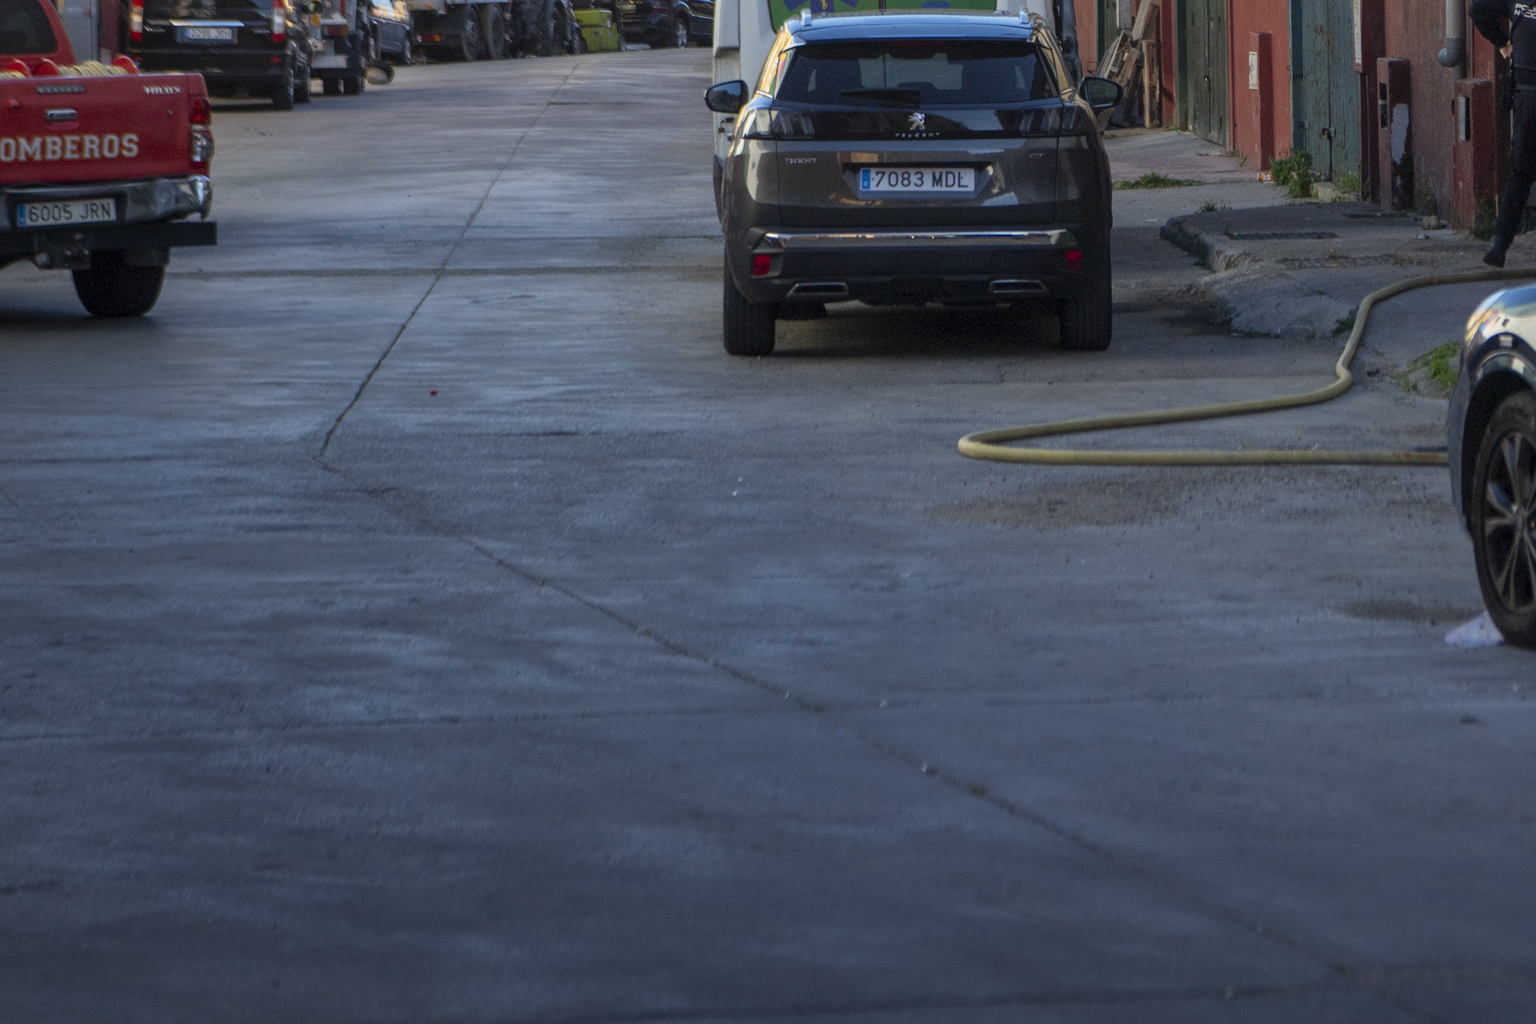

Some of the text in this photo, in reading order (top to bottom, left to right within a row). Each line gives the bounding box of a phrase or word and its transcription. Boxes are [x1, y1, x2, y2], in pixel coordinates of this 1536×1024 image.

[875, 170, 969, 188] 7083 MDL
[28, 202, 111, 223] 6005 JRN
